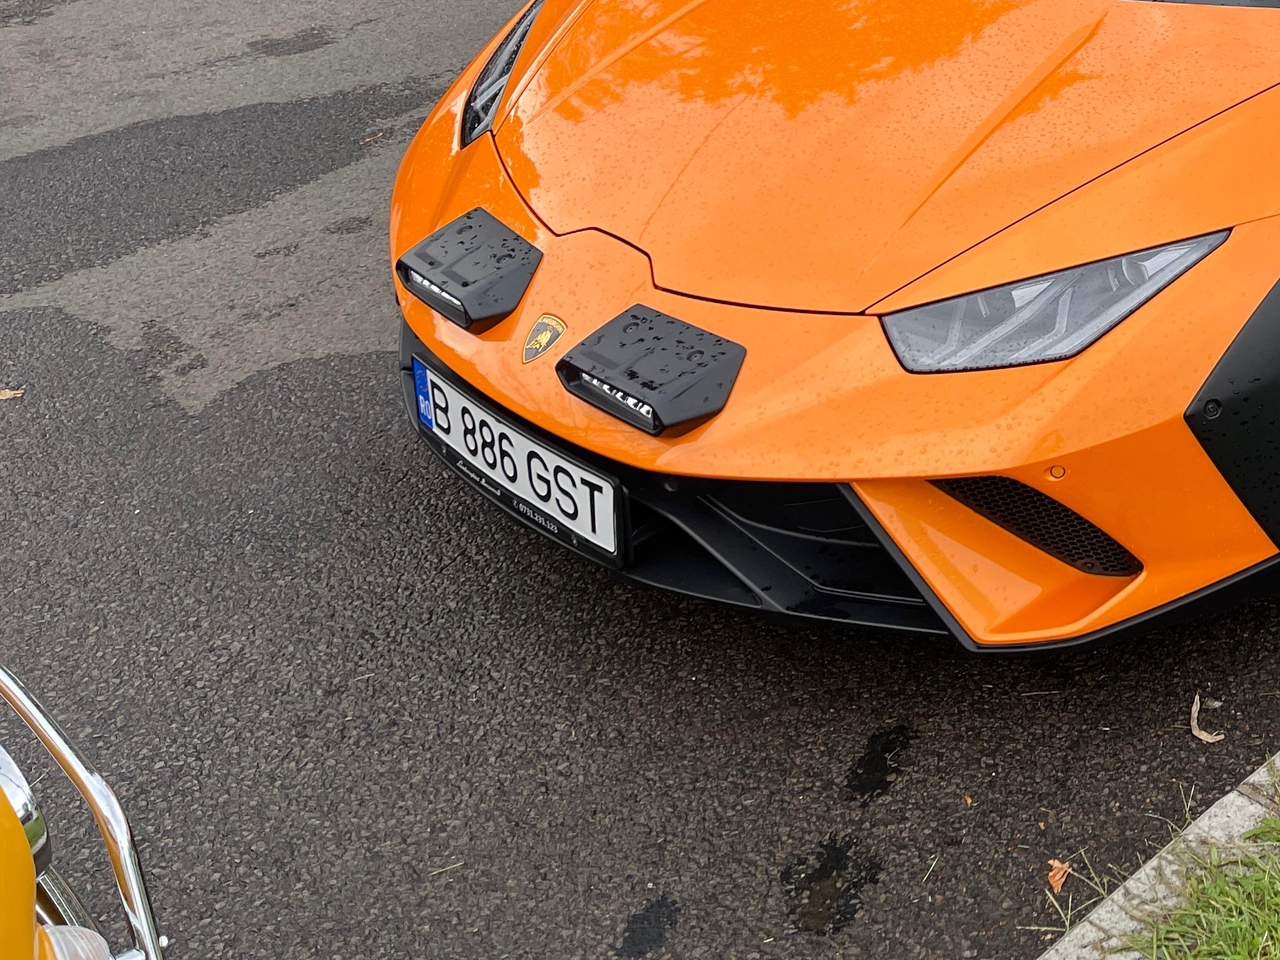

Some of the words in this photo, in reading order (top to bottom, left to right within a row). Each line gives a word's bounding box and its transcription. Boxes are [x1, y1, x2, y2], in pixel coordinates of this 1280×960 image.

[419, 394, 433, 420] RO
[430, 378, 452, 436] B
[461, 405, 518, 484] 886
[526, 450, 603, 536] GST
